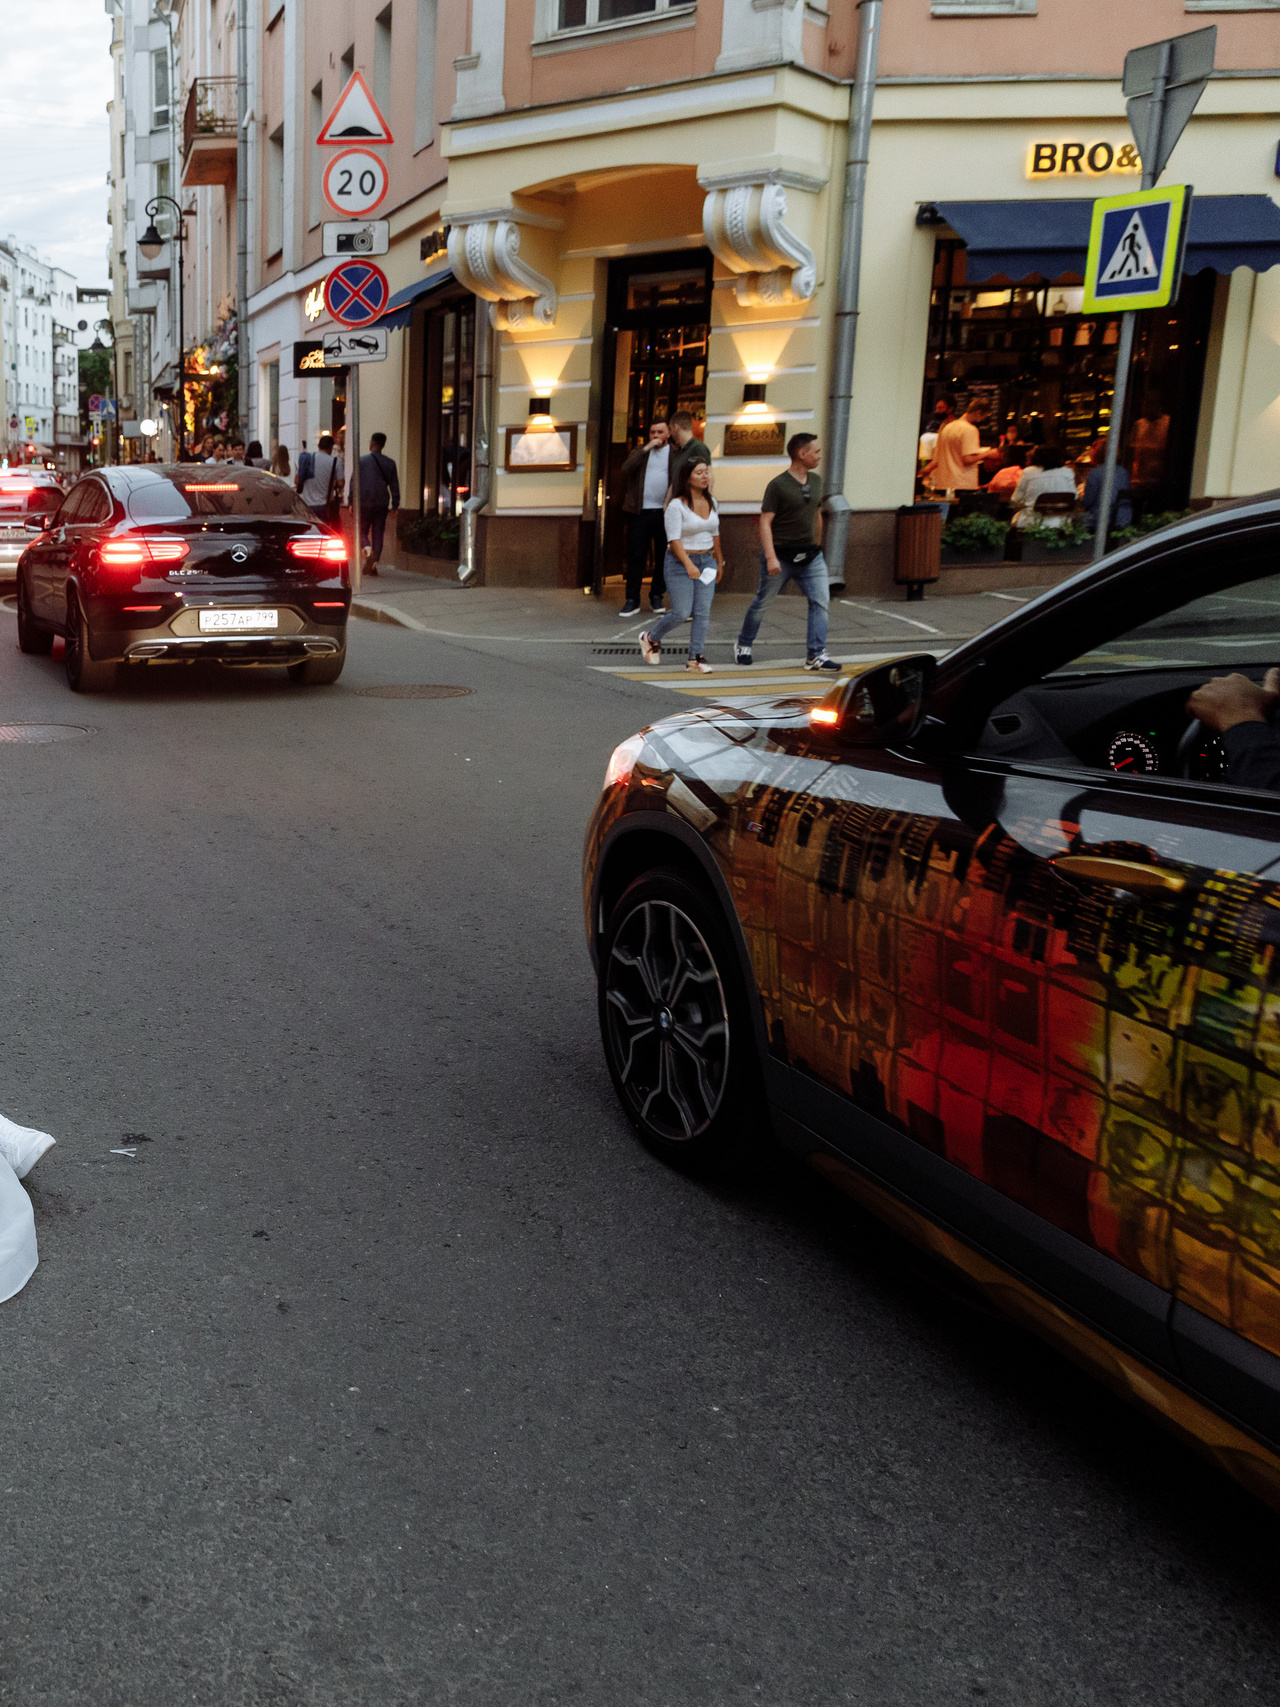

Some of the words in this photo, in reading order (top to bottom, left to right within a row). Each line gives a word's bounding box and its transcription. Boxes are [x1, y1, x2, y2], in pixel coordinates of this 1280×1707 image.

[1031, 142, 1142, 174] BRO&
[337, 170, 376, 196] 20
[256, 612, 274, 620] 799
